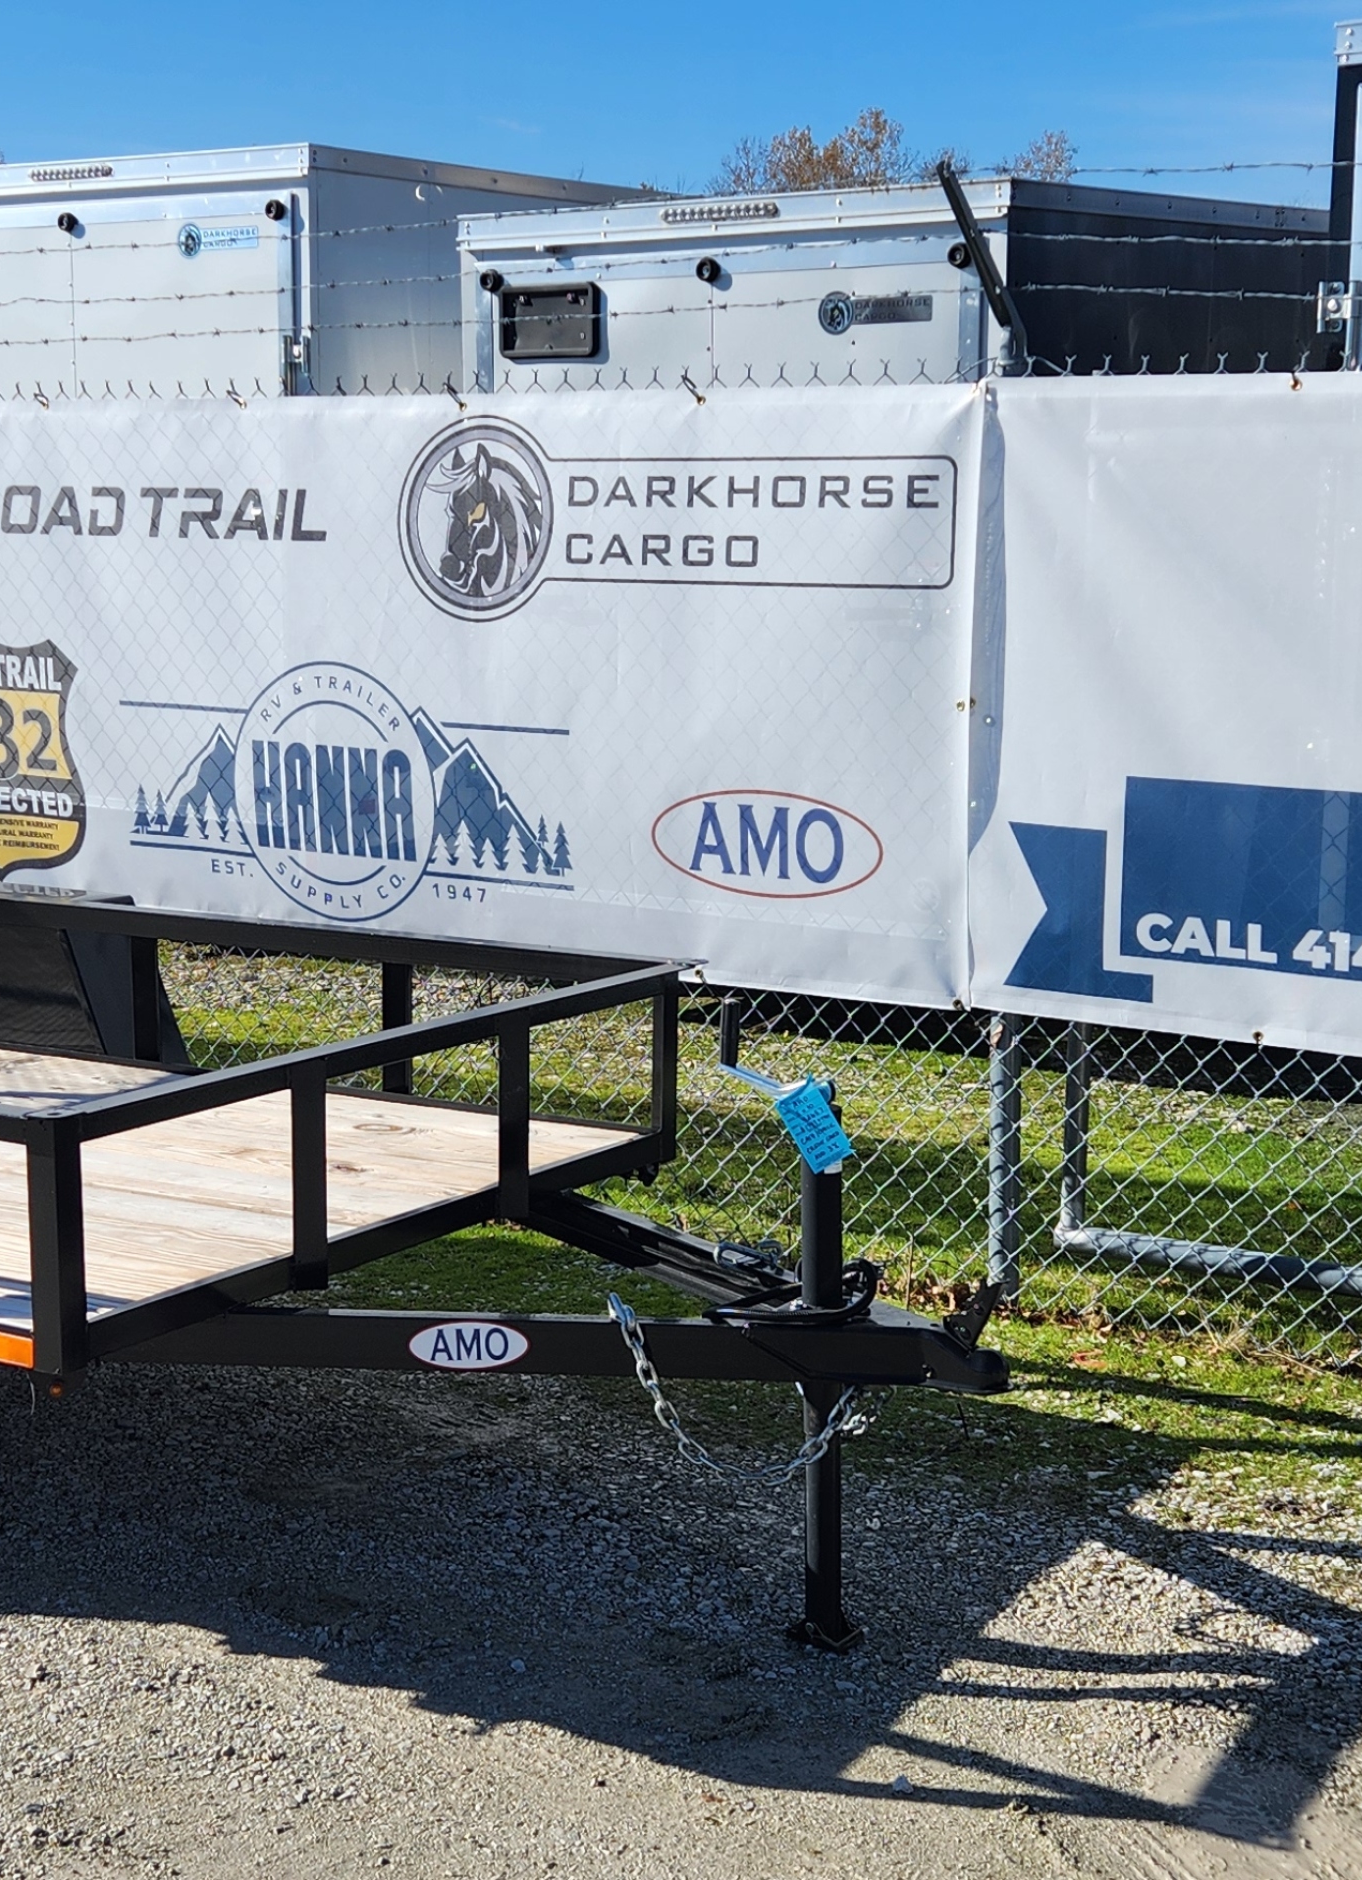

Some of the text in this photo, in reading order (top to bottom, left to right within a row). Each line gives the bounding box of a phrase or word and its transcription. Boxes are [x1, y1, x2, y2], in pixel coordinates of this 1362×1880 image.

[140, 487, 327, 541] TRAIL
[568, 474, 940, 509] DARKHORSE
[565, 533, 760, 568] CARGO
[260, 676, 400, 731] RV & TRAILER
[251, 739, 417, 862] HANNA
[18, 830, 53, 840] WARRANTY
[26, 820, 58, 830] WARRANTY
[689, 801, 844, 884] AMO
[211, 859, 486, 902] EST. 1947
[276, 862, 406, 909] SUPPLY CO.
[1136, 913, 1277, 963] CALL
[430, 1327, 508, 1361] AMO
